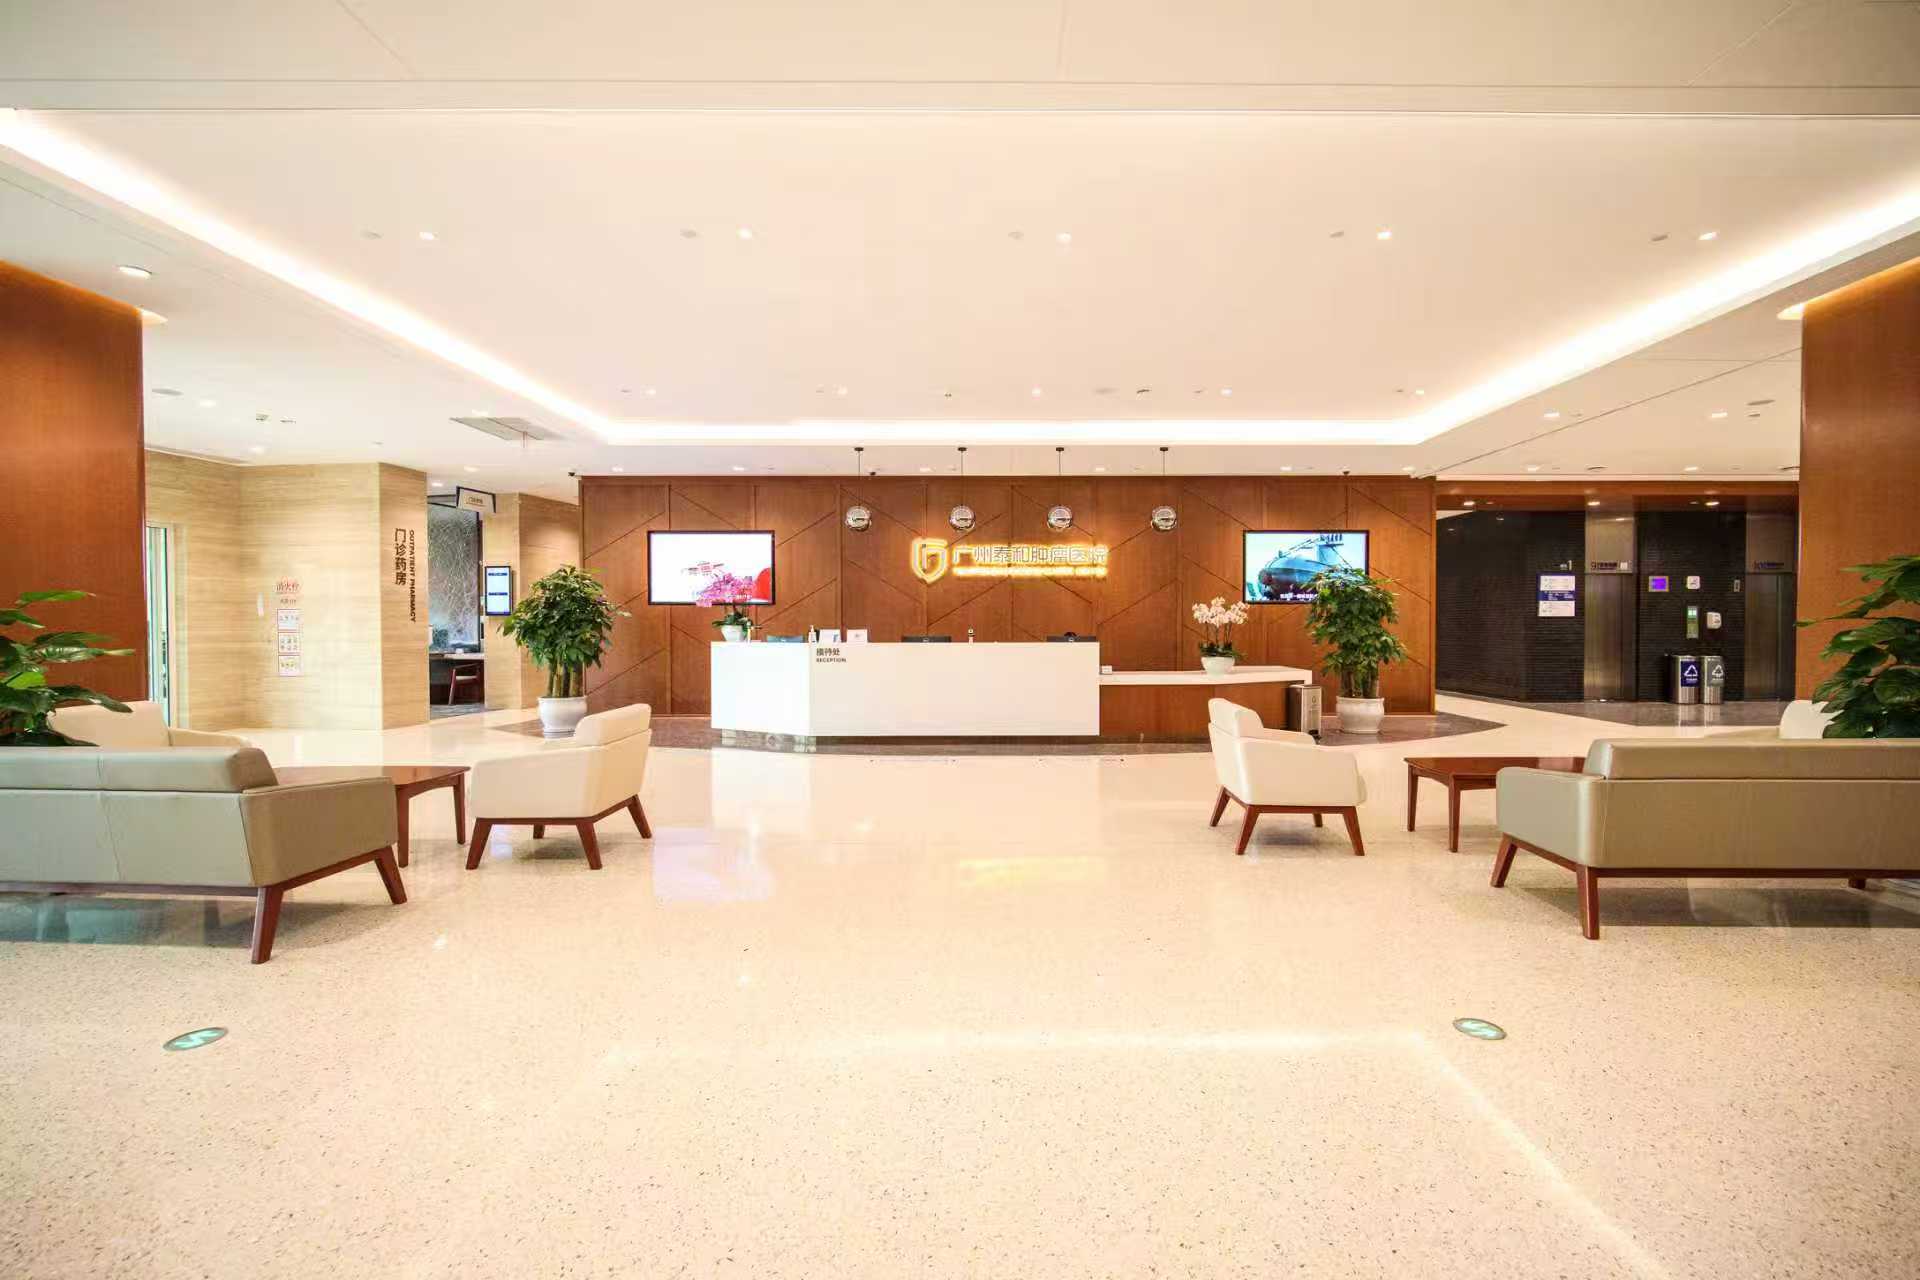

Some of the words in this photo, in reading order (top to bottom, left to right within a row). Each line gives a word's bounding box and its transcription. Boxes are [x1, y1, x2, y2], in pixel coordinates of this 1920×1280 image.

[395, 528, 406, 586] 门诊药房
[953, 546, 1106, 563] 广州泰和肿瘤医院
[816, 648, 840, 656] 接待处
